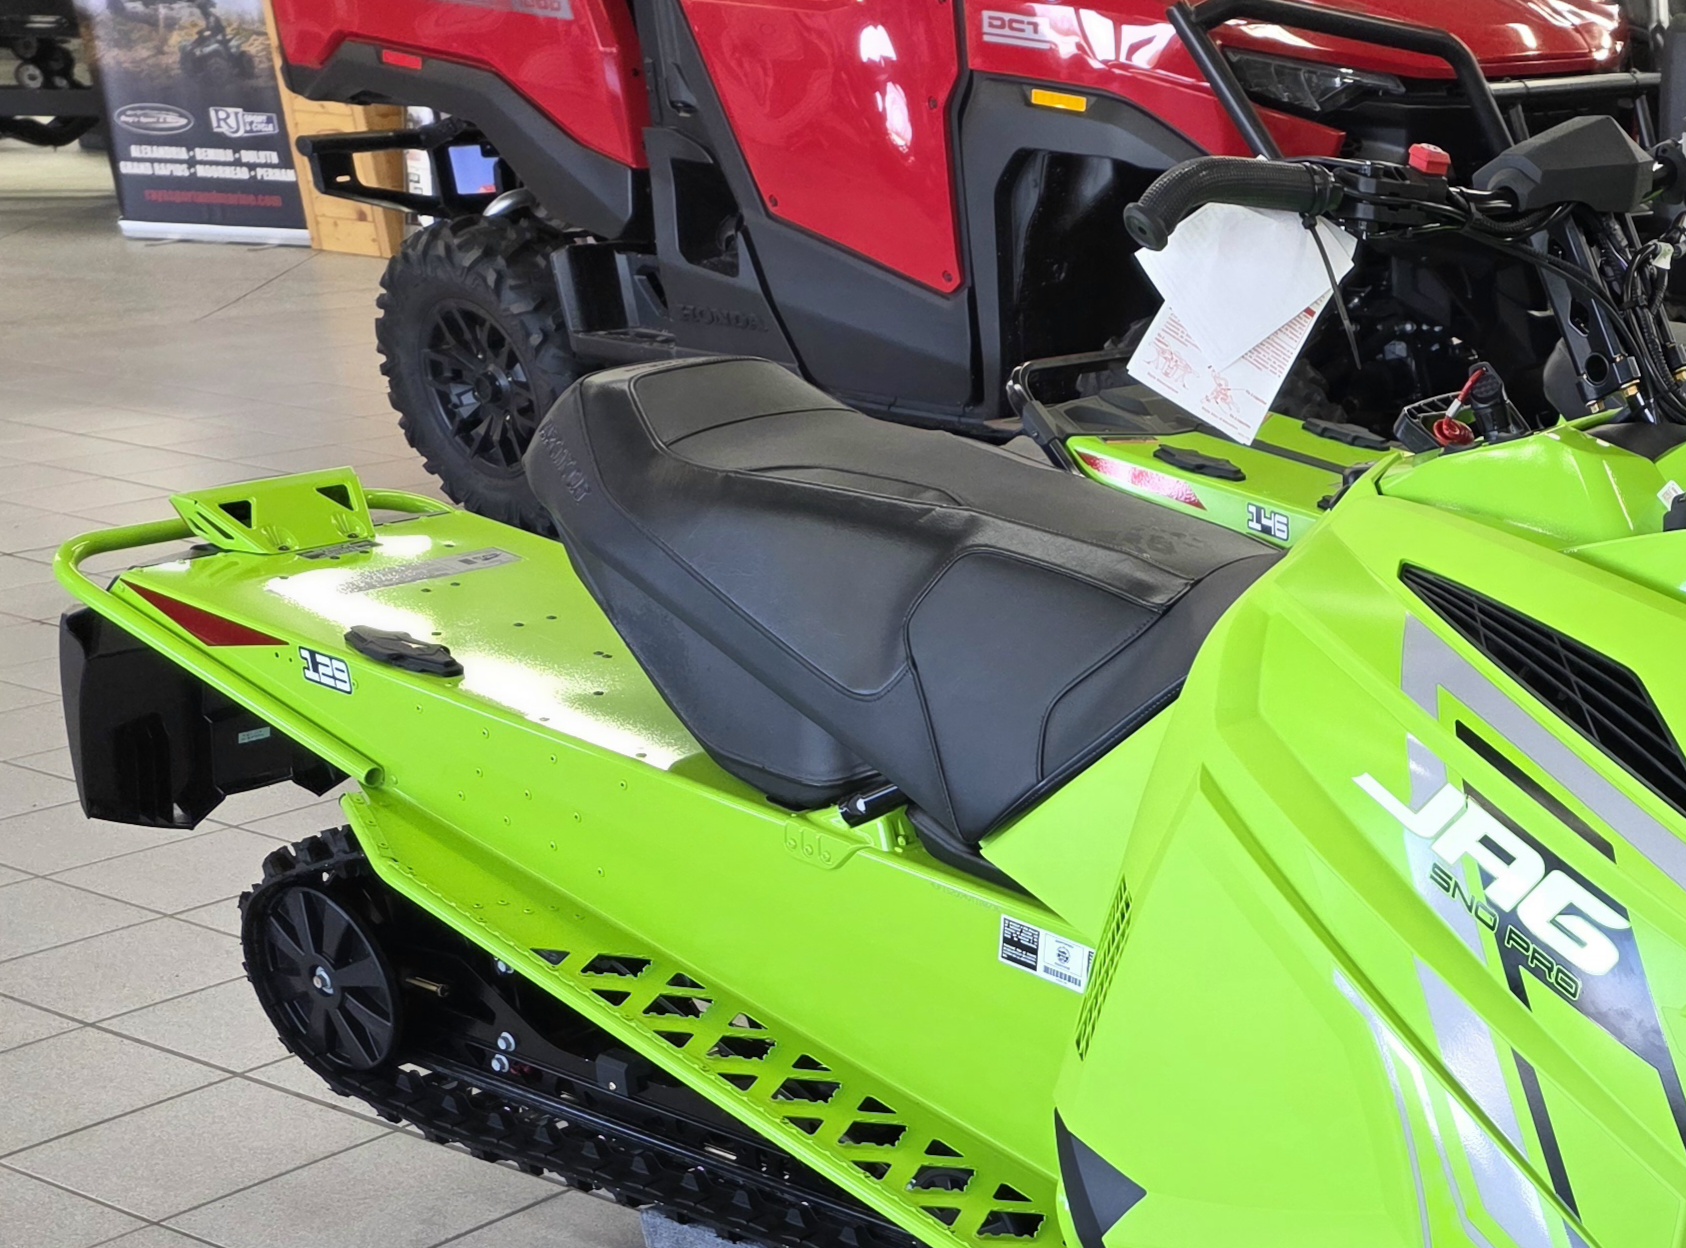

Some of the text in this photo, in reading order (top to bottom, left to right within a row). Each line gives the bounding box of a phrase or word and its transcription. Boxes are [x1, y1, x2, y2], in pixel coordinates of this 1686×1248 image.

[987, 15, 1041, 35] DCT
[214, 108, 242, 134] RJ
[1247, 503, 1289, 540] 146
[299, 647, 352, 694] 129
[1352, 772, 1632, 976] JAG
[1429, 862, 1582, 1000] SNO PRO
